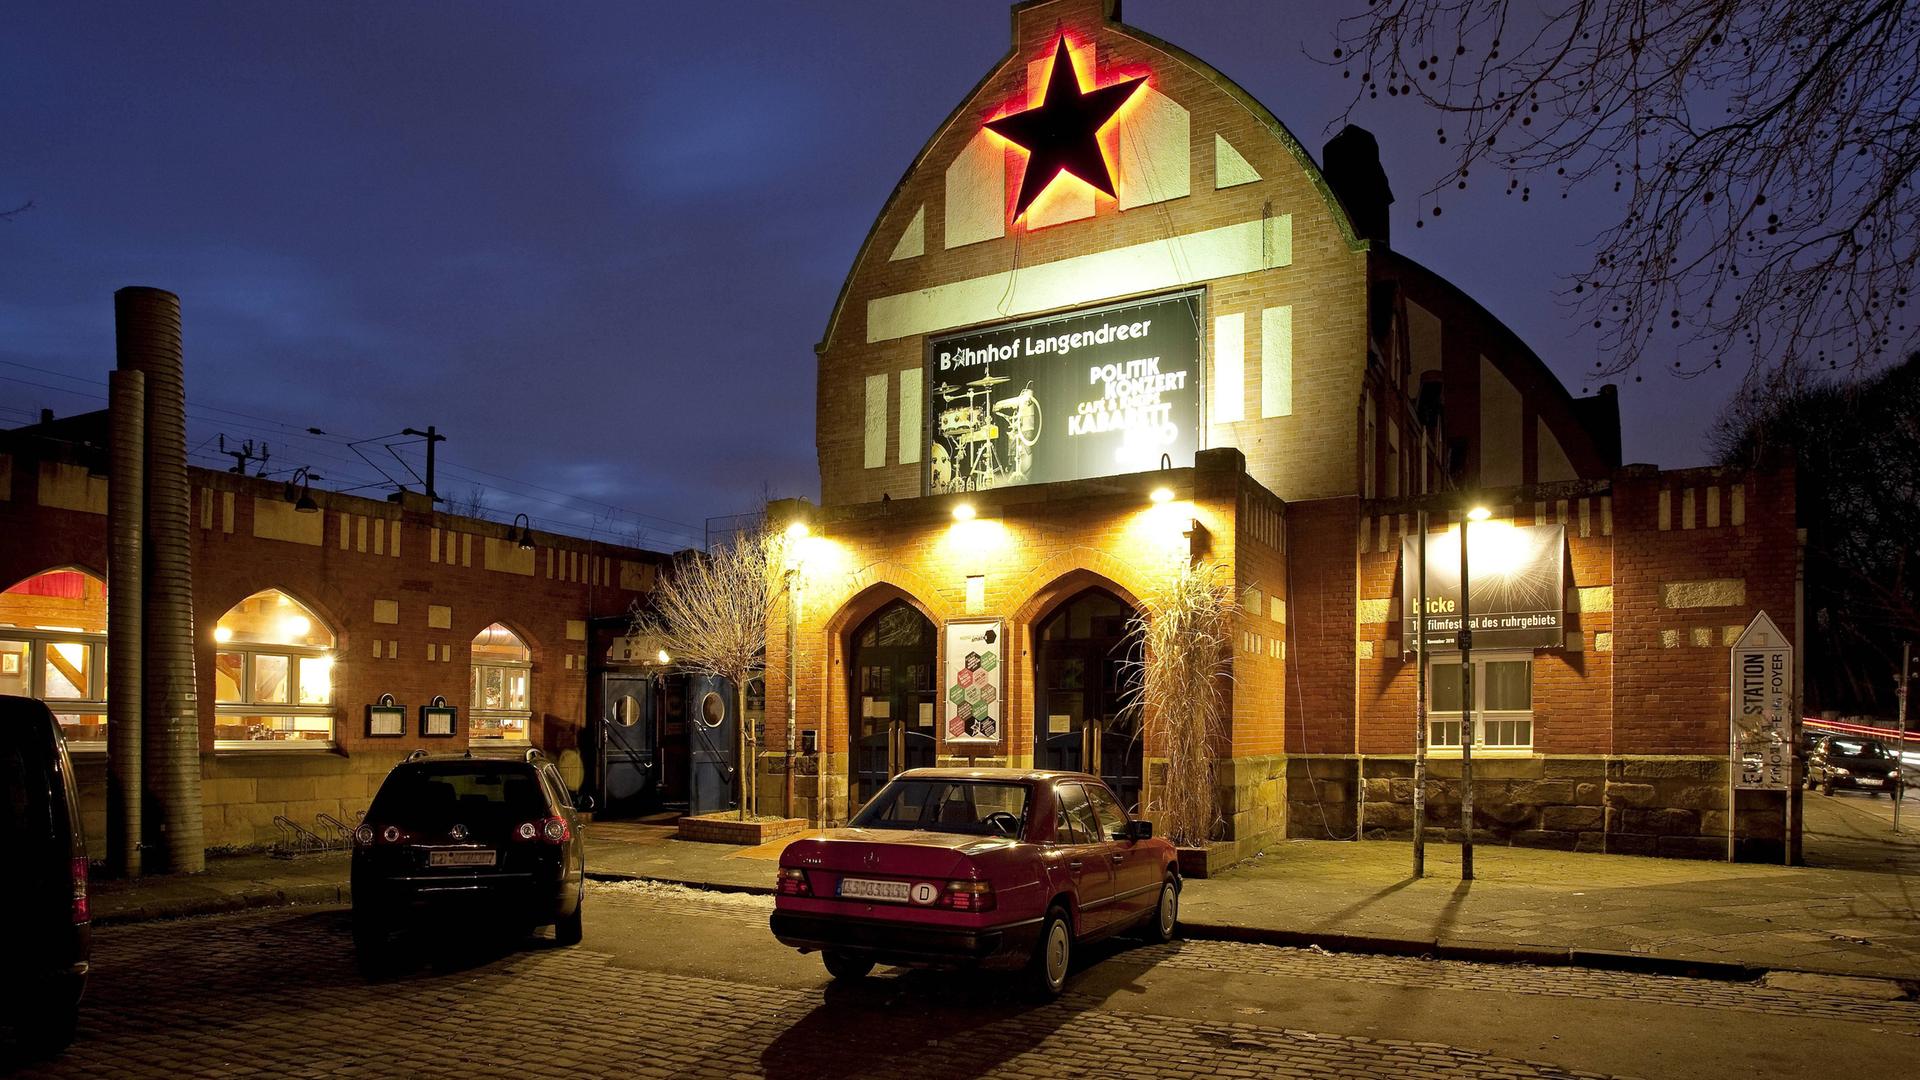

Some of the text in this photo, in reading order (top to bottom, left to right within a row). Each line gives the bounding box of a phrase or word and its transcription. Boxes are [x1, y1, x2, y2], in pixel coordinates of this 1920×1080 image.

[1025, 320, 1151, 355] Langendreer
[1090, 357, 1161, 385] POLITIK
[1105, 371, 1188, 399] KONZERT
[1412, 597, 1455, 614] bicke
[1482, 617, 1498, 629] des
[1501, 614, 1556, 629] ruhrgebiets
[1743, 653, 1764, 716] STATION
[1771, 653, 1783, 694] FOYER
[919, 886, 930, 900] D
